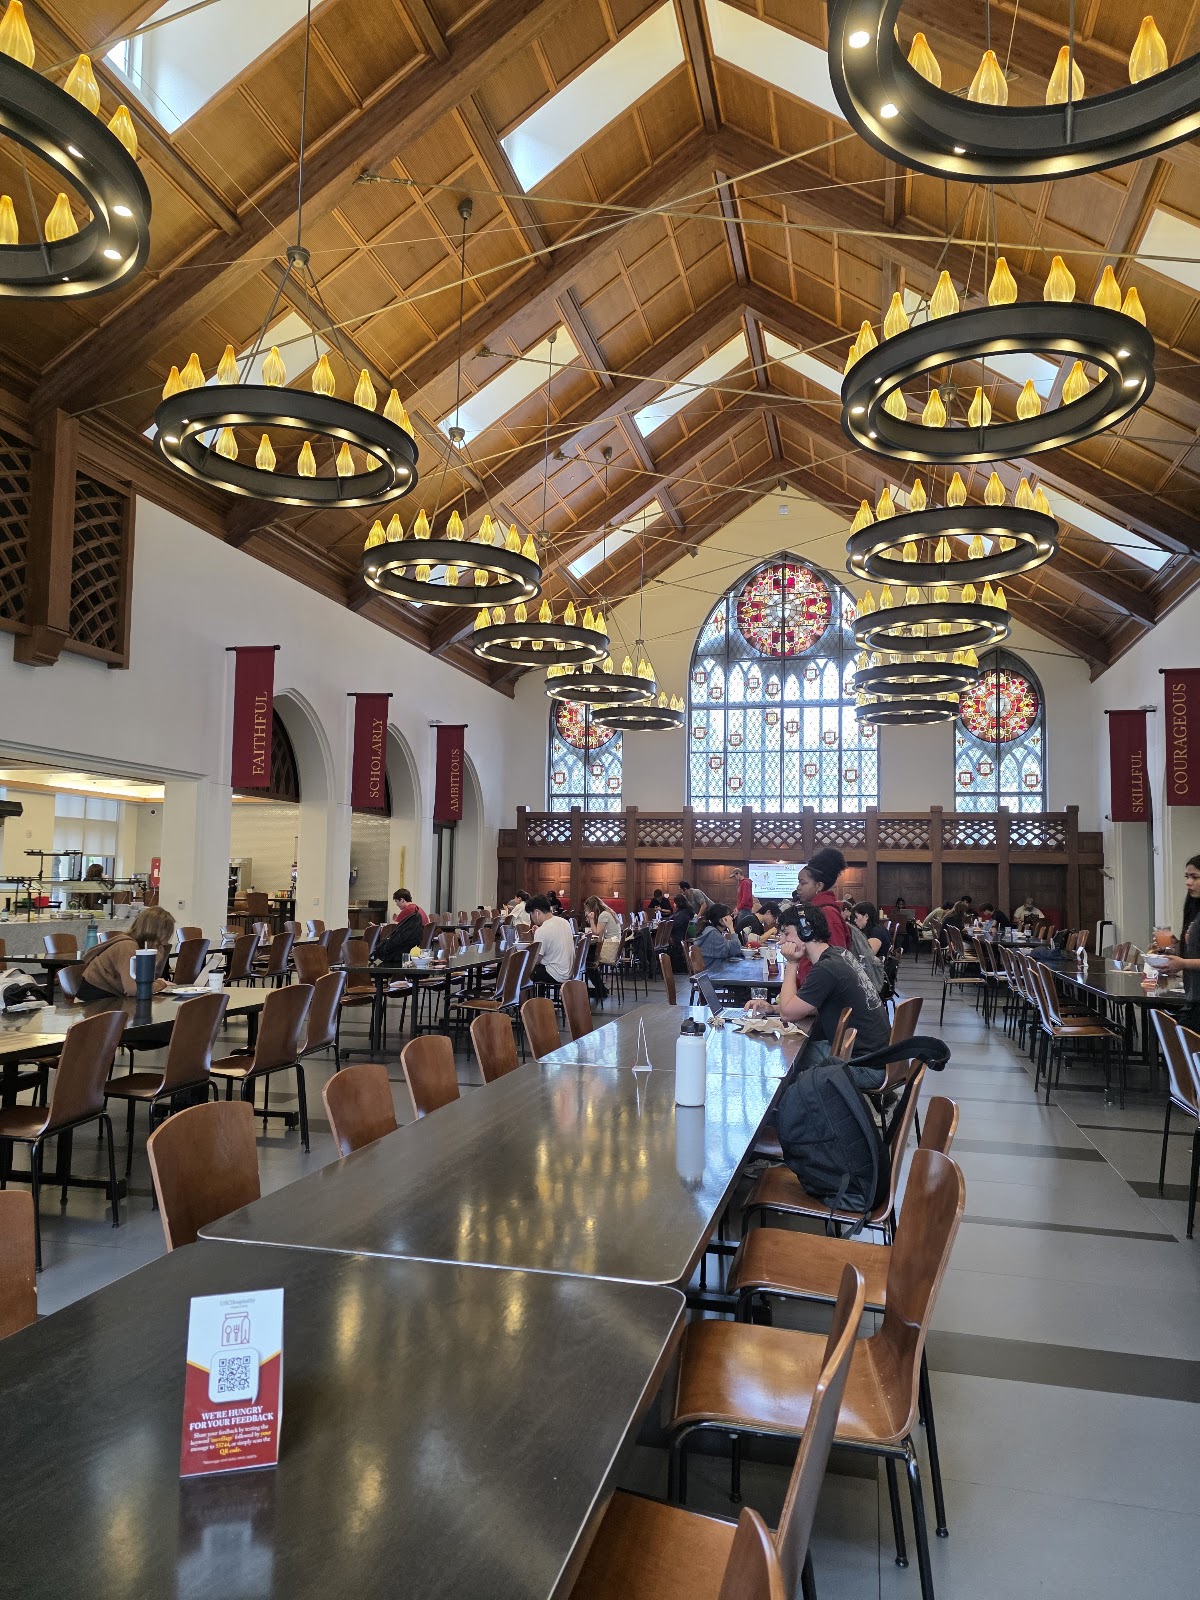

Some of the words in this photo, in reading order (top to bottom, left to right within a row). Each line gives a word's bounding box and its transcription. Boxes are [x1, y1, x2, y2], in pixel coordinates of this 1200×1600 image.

[252, 691, 268, 776] FAITHFUL
[369, 718, 383, 798] SCHOLARLY
[1172, 683, 1188, 795] COURAGEOUS
[450, 748, 460, 813] AMBITIOUS
[1131, 750, 1144, 813] SKILLFUL
[189, 1421, 207, 1430] FOR
[207, 1418, 230, 1428] YOUR
[231, 1413, 274, 1425] FEEDBACK
[202, 1410, 227, 1420] WE'RE
[228, 1406, 263, 1417] HUNGRY
